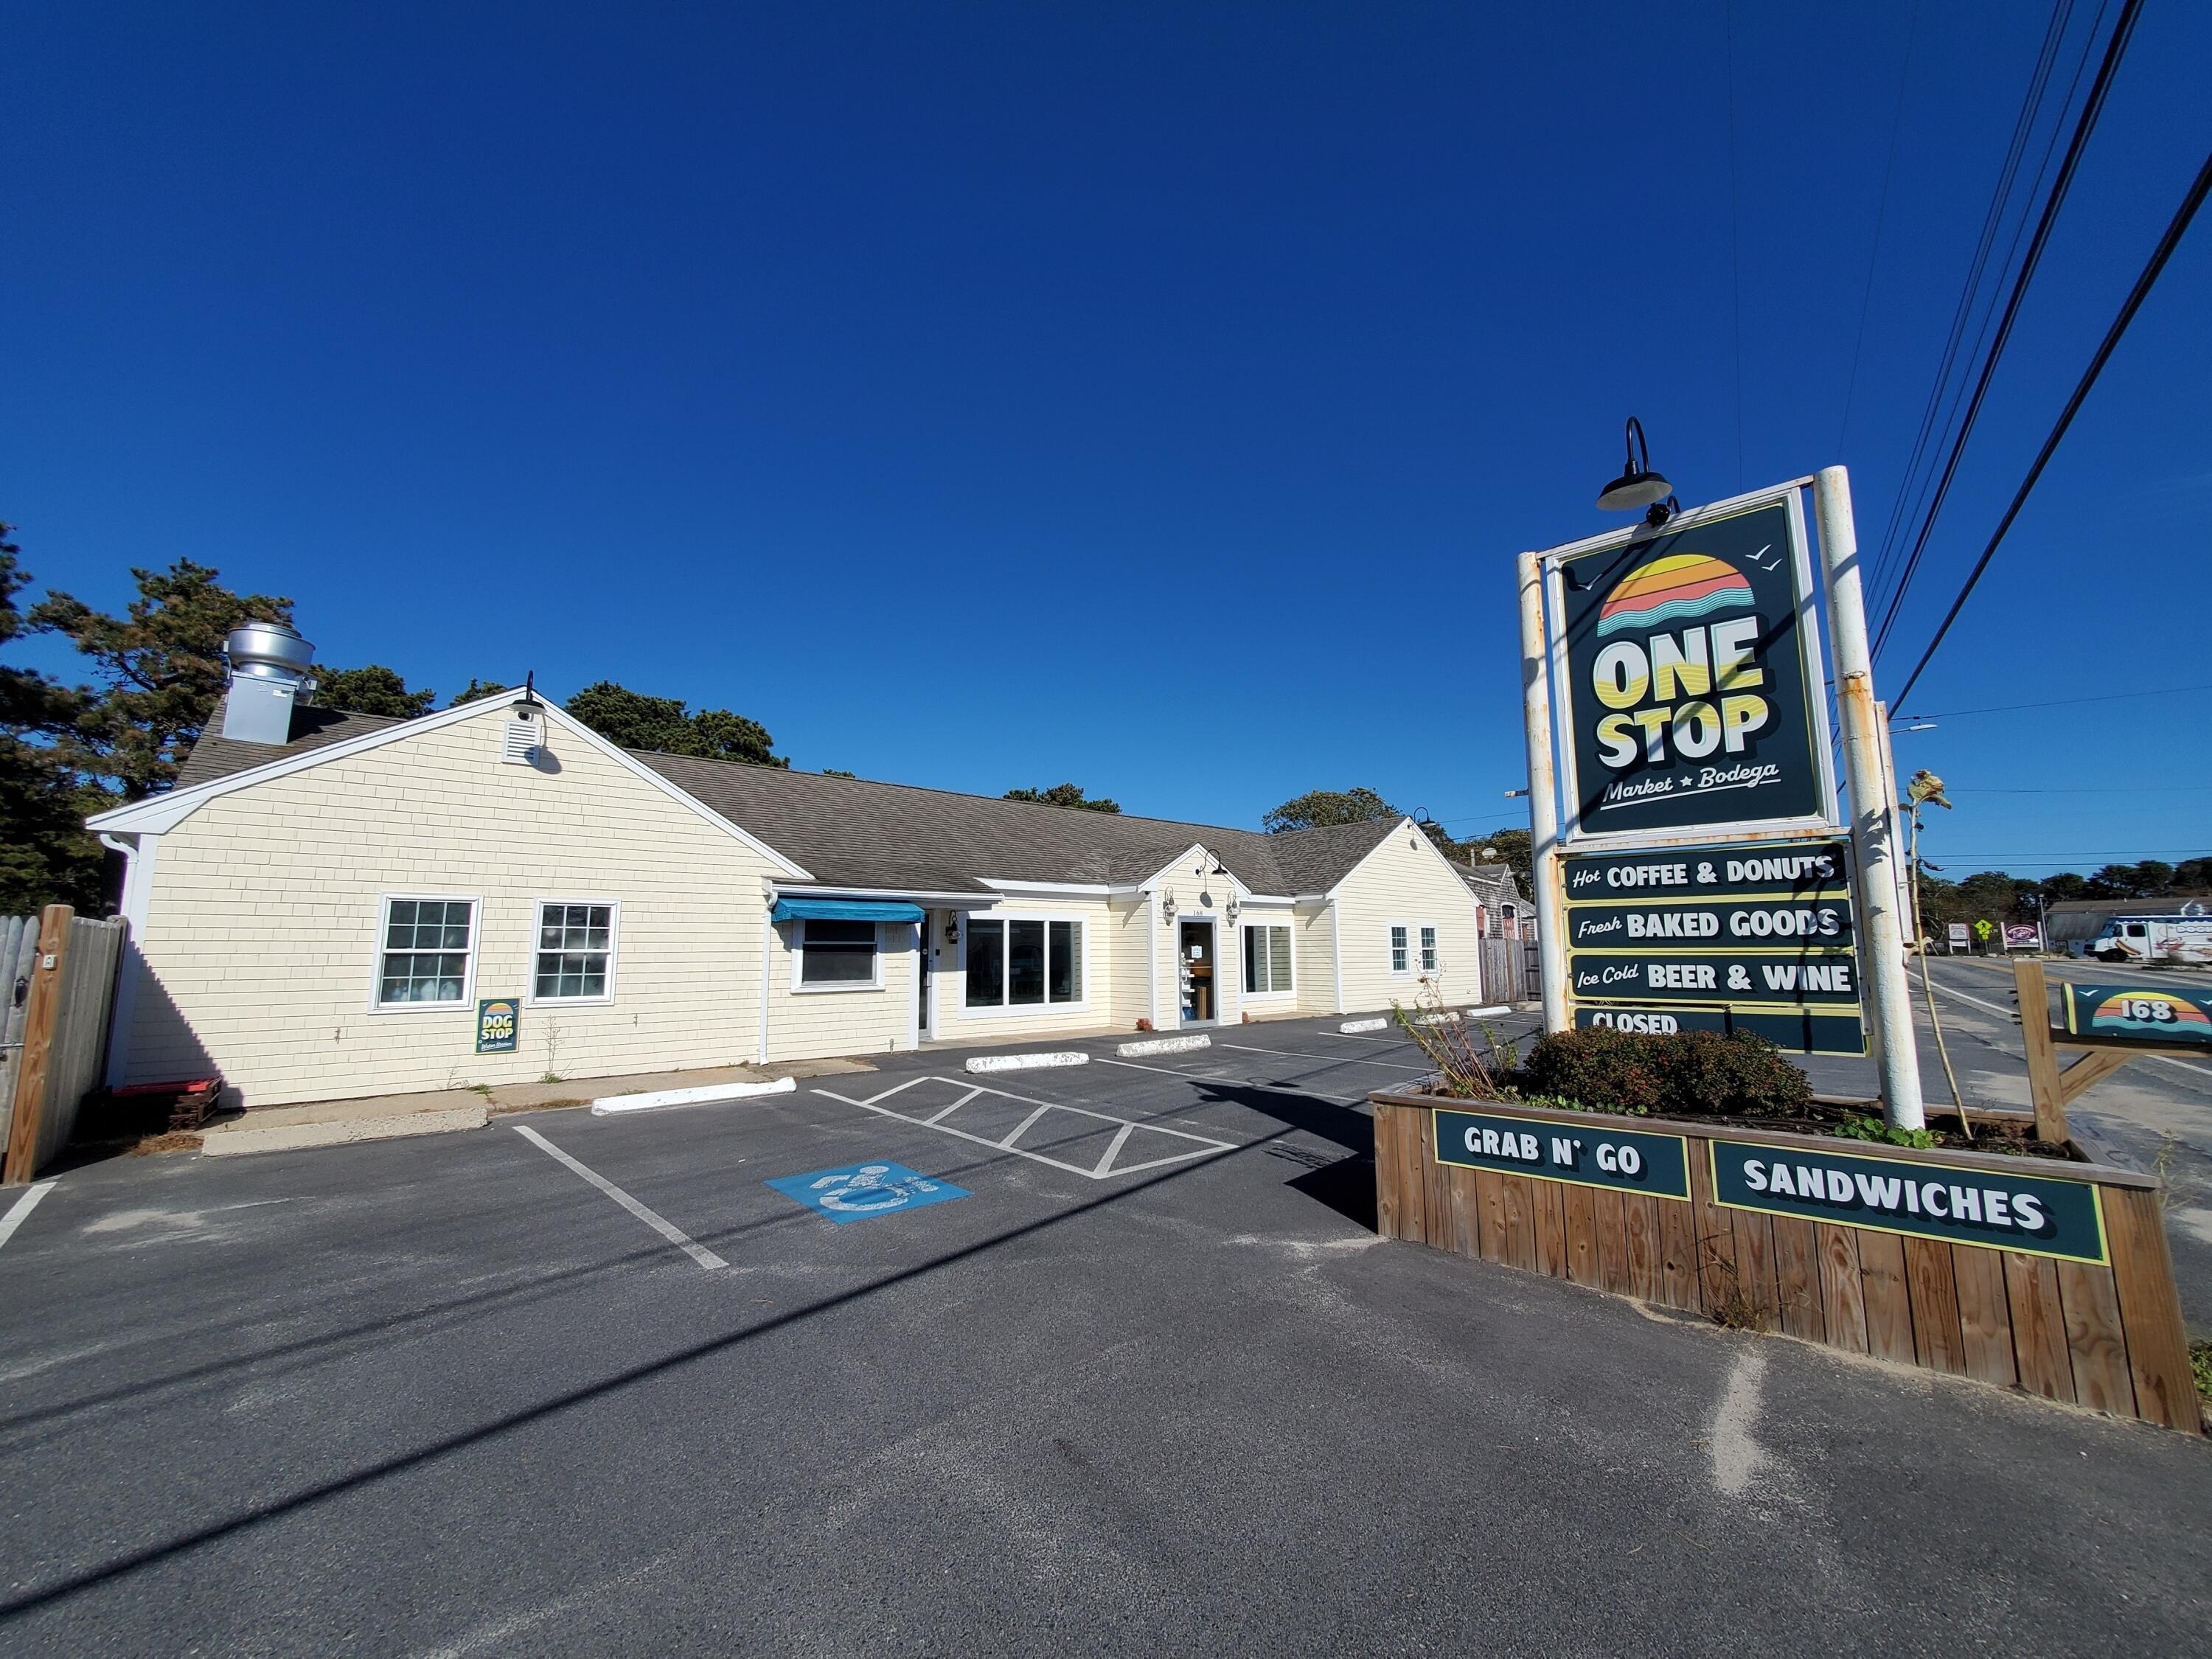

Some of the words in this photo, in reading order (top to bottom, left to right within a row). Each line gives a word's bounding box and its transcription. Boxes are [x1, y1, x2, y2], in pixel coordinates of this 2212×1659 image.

[1593, 616, 1764, 709] ONE
[1597, 695, 1769, 768] STOP
[1602, 777, 1673, 803] Market
[1697, 763, 1780, 788] Bodega
[1573, 869, 1601, 888] Hot
[1607, 863, 1688, 887] COFFEE
[1697, 861, 1718, 883] &
[1727, 855, 1834, 883] DONUTS
[1578, 916, 1622, 939] Fresh
[1627, 913, 1719, 938] BAKED
[1730, 908, 1840, 936] GOODS
[1577, 971, 1599, 989] Ice
[1602, 964, 1639, 986] Cold
[1647, 964, 1717, 989] BEER
[1727, 964, 1752, 990] &
[1761, 965, 1851, 992] WINE
[483, 1015, 512, 1029] DOG
[2121, 1000, 2171, 1020] 168
[481, 1028, 513, 1040] STOP
[1464, 1126, 1540, 1161] GRAB
[1596, 1143, 1641, 1175] GO
[1743, 1159, 2046, 1231] SANDWICHES
